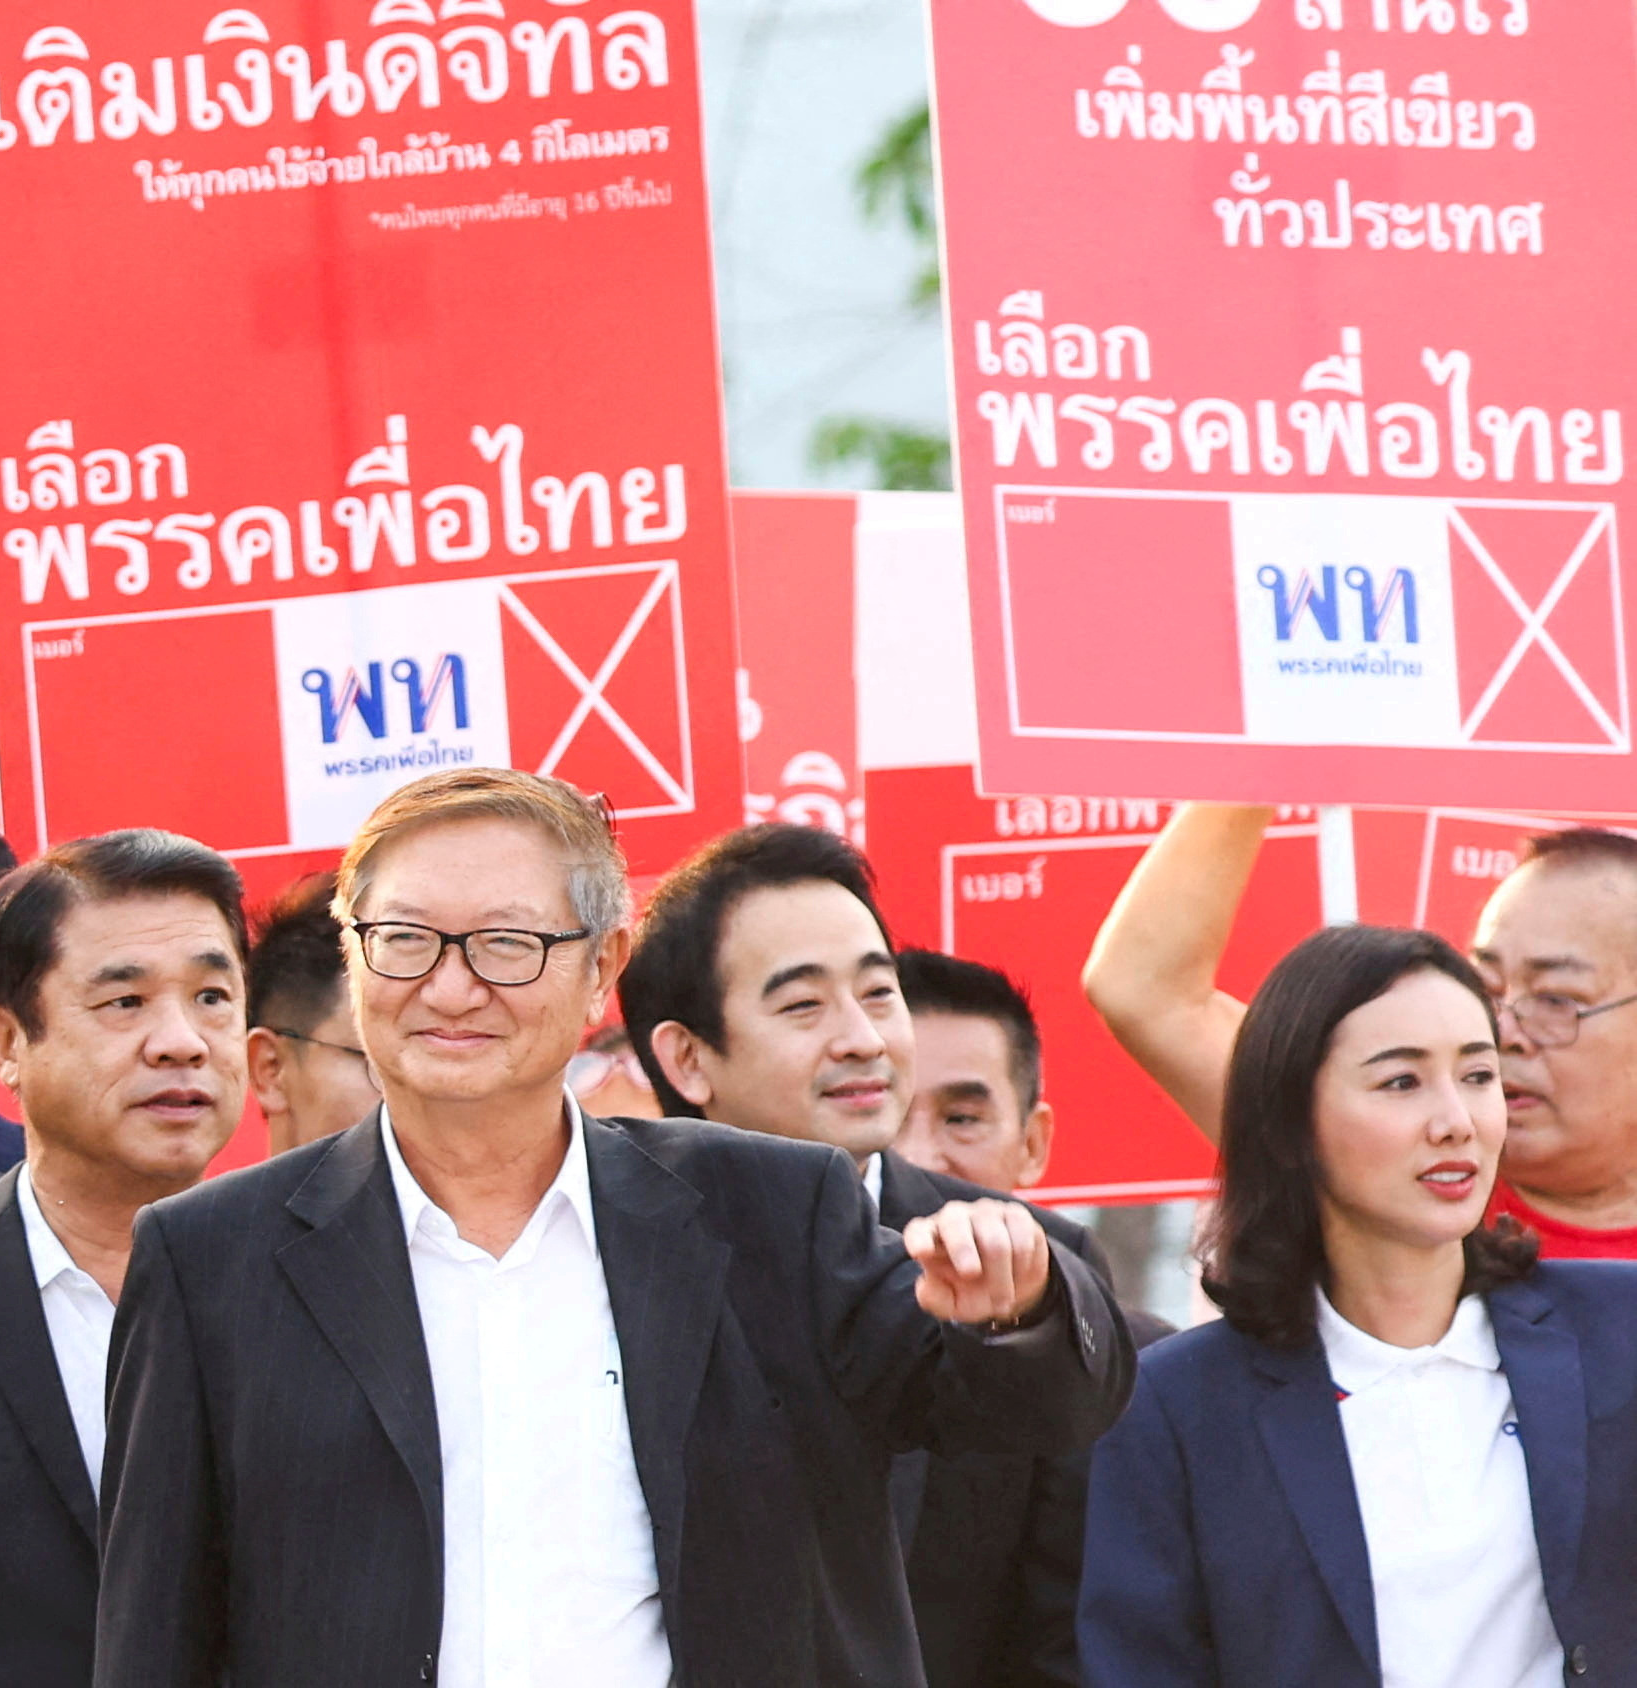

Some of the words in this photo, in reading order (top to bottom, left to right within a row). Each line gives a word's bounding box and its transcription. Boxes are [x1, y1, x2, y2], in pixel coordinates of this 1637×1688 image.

[1075, 44, 1536, 152] เพิ่มพื้นที่สีเขียว
[132, 131, 491, 211] ให้ทุกคนใช้จ่ายใกล้บ้าน
[500, 140, 522, 164] 4
[532, 119, 669, 162] กิโลเมตร
[1214, 153, 1543, 254] ทั่วประเทศ
[975, 290, 1150, 380] เลือก
[975, 327, 1623, 485] พรรคเพื่อไทย
[0, 419, 189, 513] เลือก
[2, 415, 687, 604] พรรคเพื่อไทย
[1258, 565, 1418, 643] พท
[302, 654, 468, 744] พท
[1277, 650, 1422, 676] พรรคเพื่อไทย
[323, 739, 474, 777] พรรคเพื่อไทย
[962, 856, 1047, 902] เบอร์
[1451, 845, 1517, 879] เบอ
